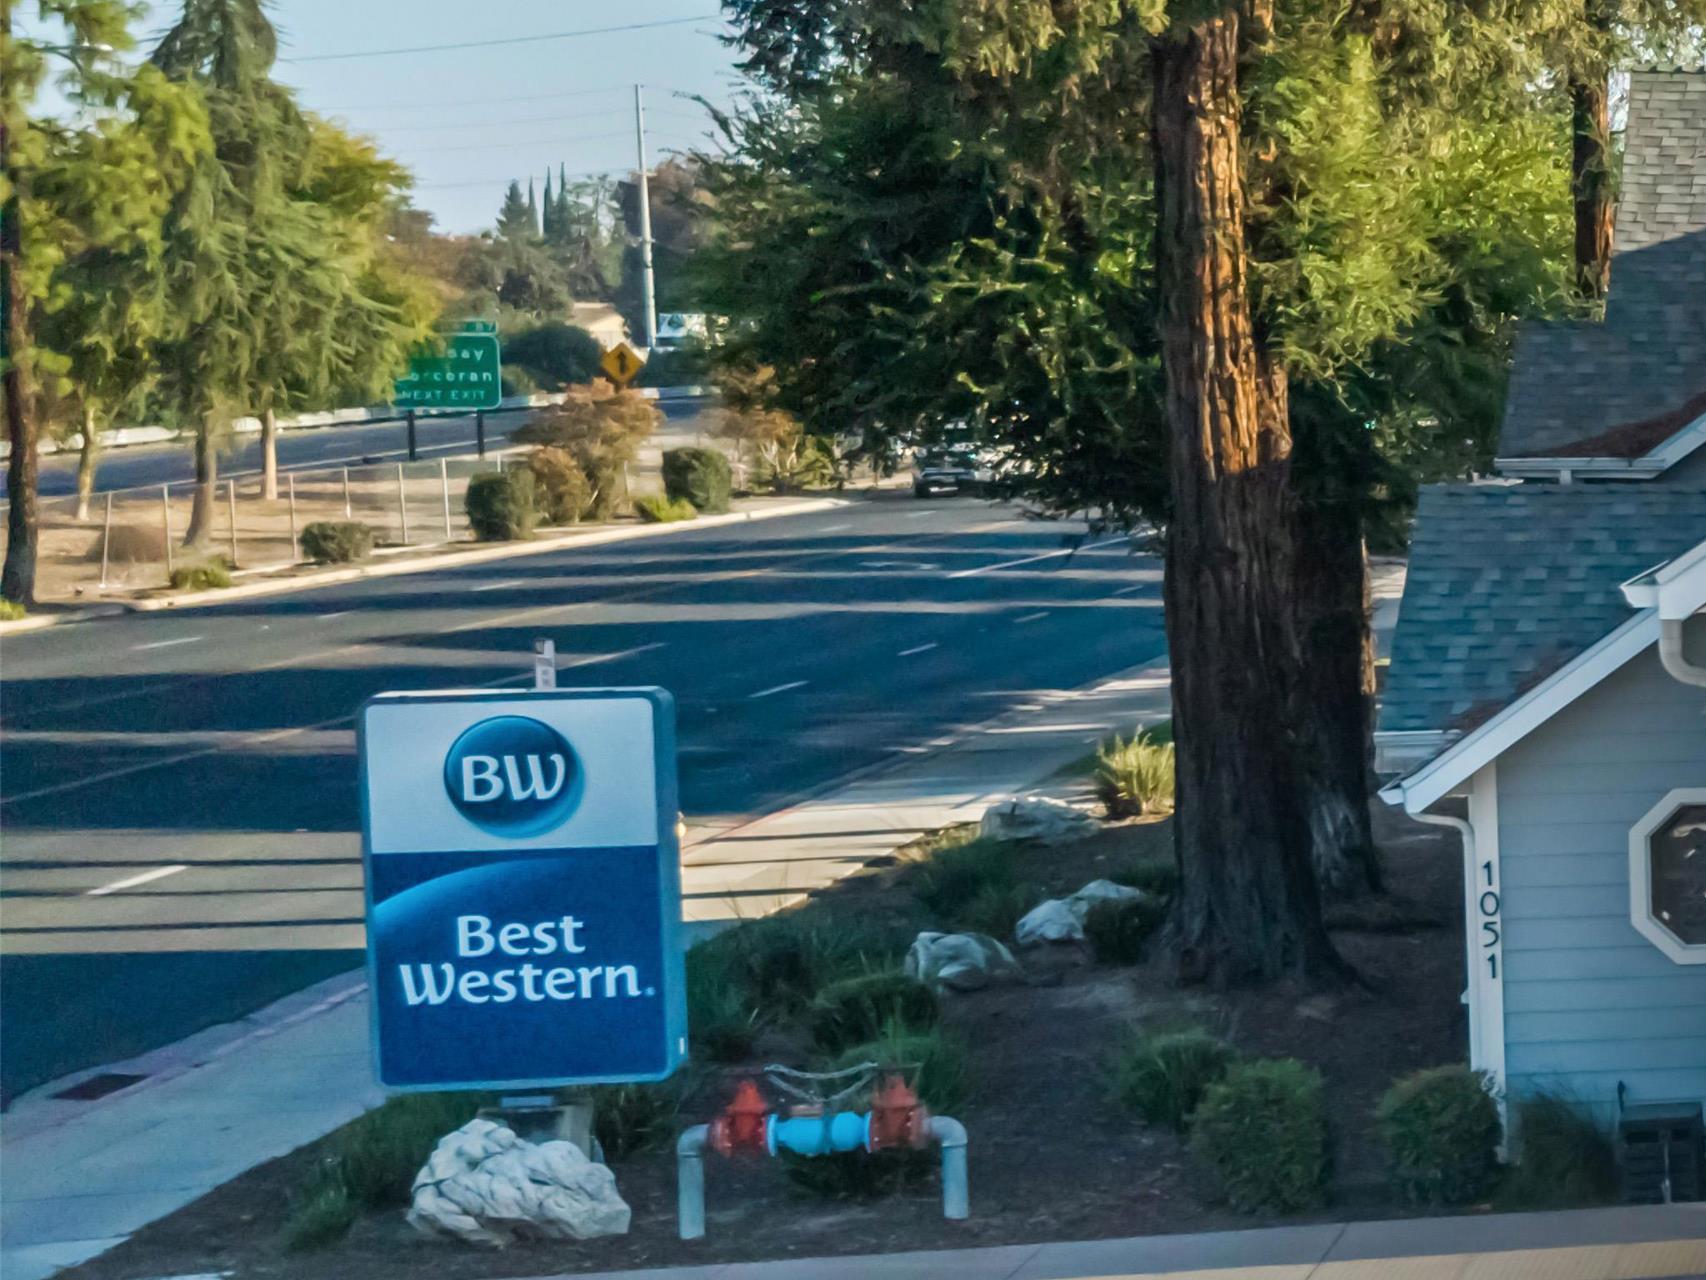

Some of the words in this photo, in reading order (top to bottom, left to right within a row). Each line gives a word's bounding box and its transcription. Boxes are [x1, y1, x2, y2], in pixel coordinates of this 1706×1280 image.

[451, 390, 486, 400] EXIT
[462, 753, 566, 802] BW
[457, 915, 586, 957] Best
[1480, 860, 1500, 979] 1051
